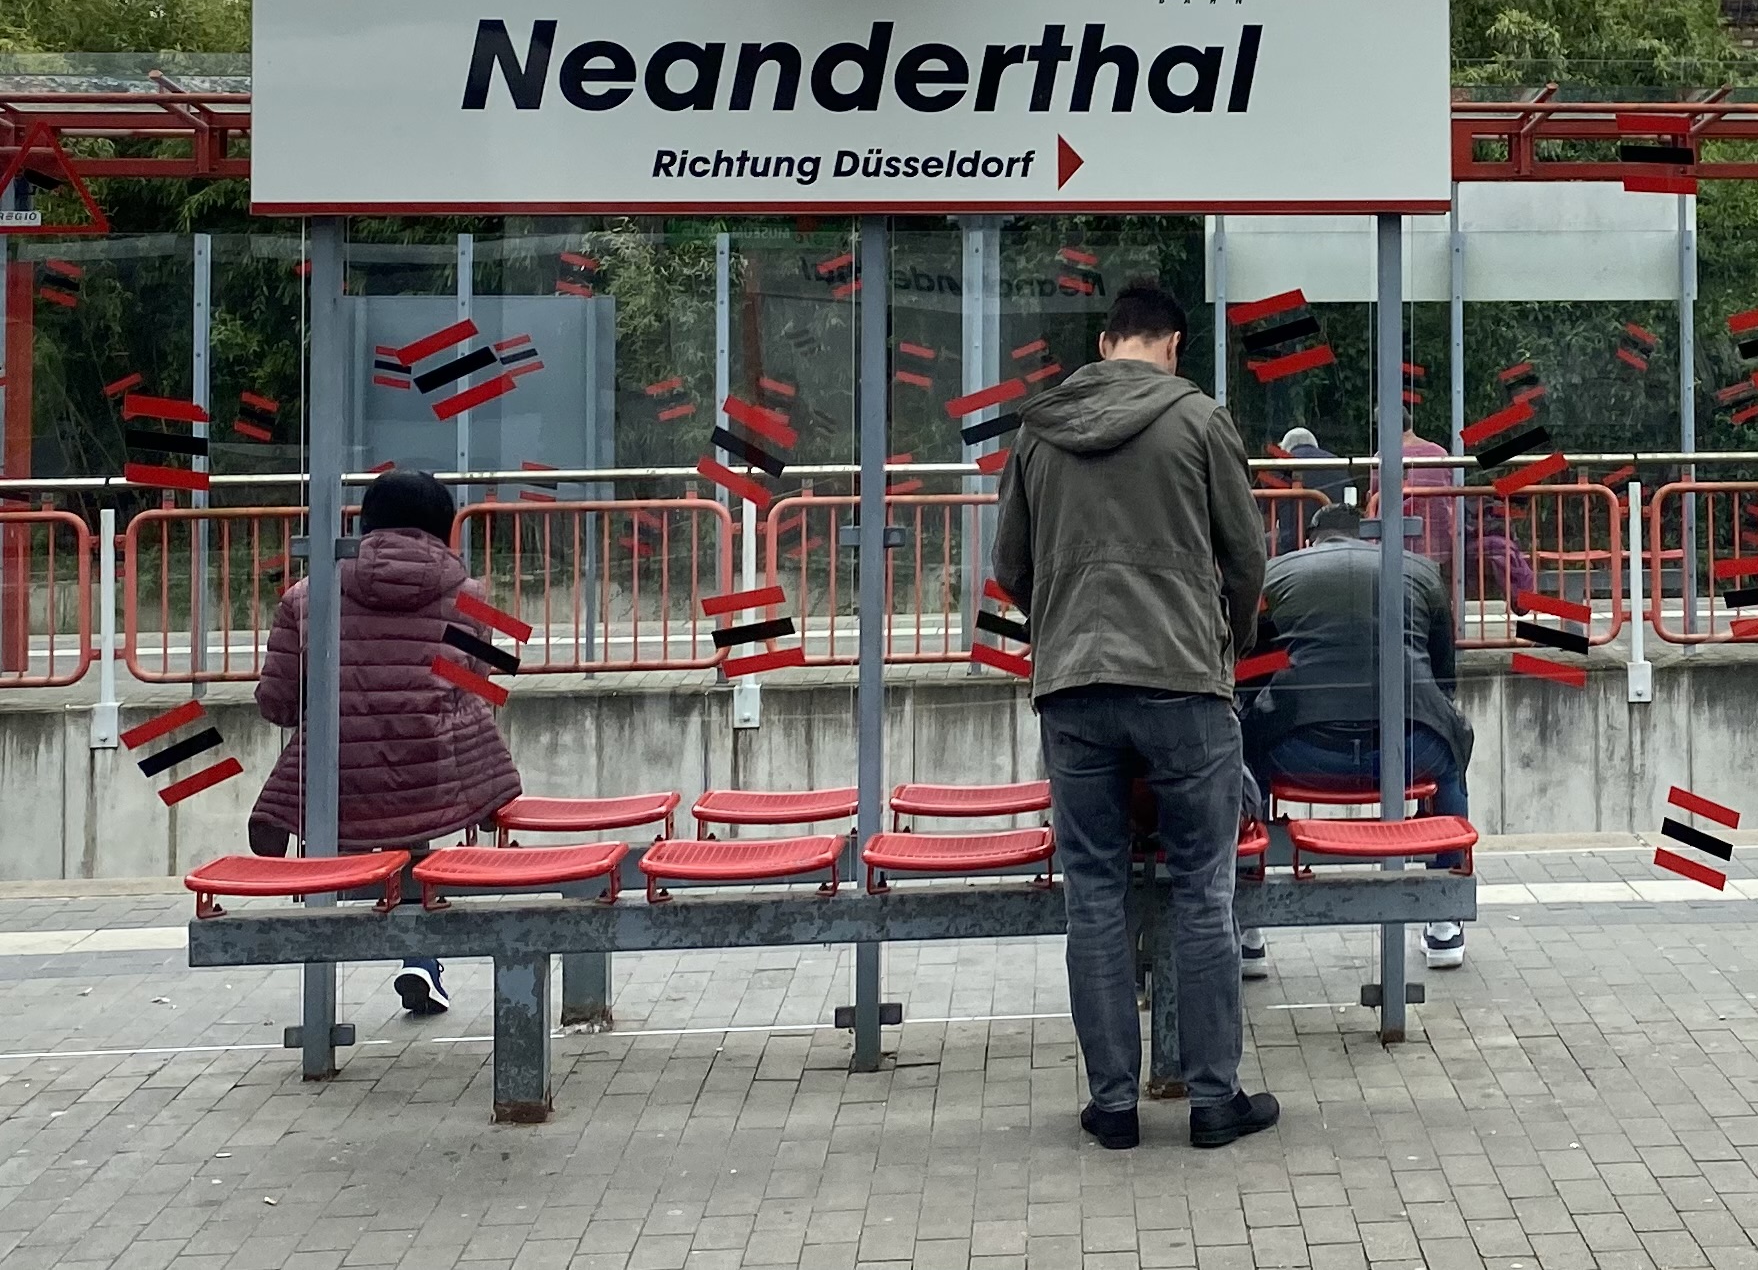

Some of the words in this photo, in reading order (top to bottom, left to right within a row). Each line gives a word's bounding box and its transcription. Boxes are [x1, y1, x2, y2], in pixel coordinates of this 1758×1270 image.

[461, 18, 1264, 113] Neanderthal
[652, 150, 821, 185] Richtung
[832, 148, 1036, 178] Düsseldorf
